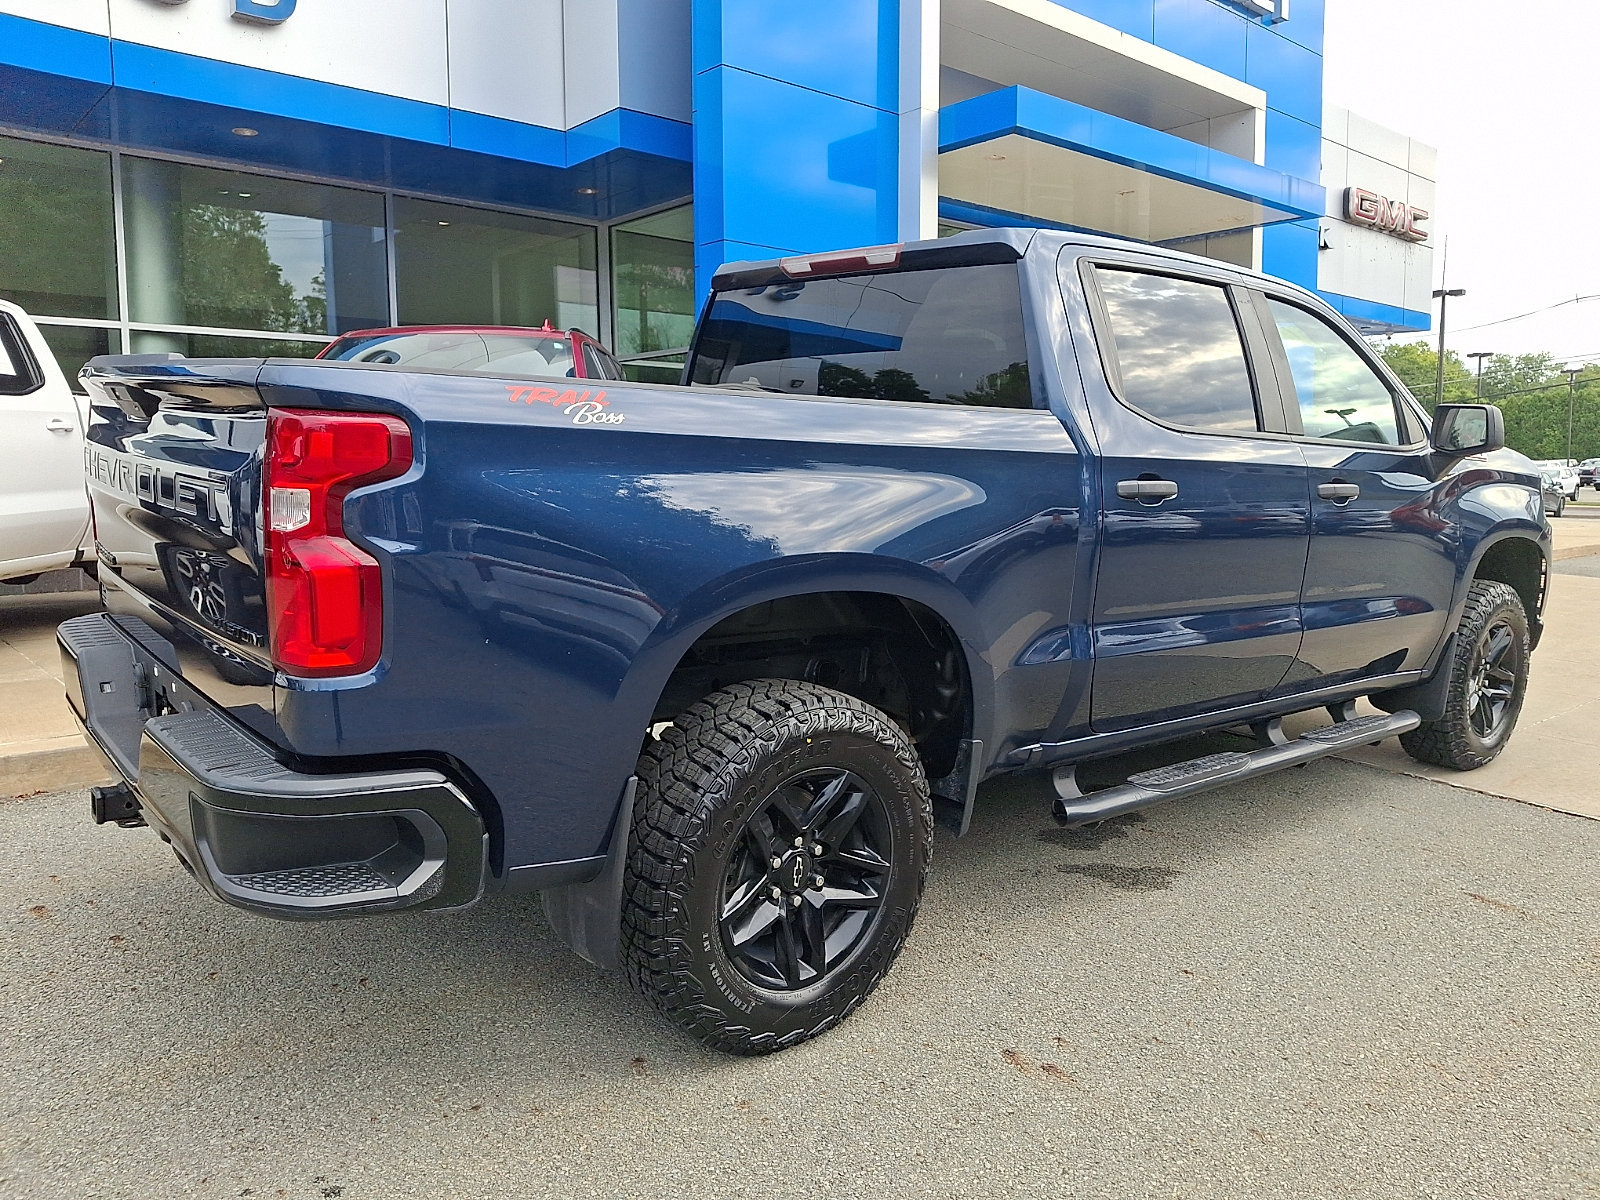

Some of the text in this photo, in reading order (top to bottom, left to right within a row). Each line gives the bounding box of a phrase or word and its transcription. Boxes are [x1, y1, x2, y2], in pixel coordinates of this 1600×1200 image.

[1348, 187, 1429, 241] GMC
[505, 385, 610, 407] TRAIL
[563, 401, 625, 425] Boss
[84, 446, 227, 522] CHEVROLET
[708, 961, 756, 1014] TERRITORY
